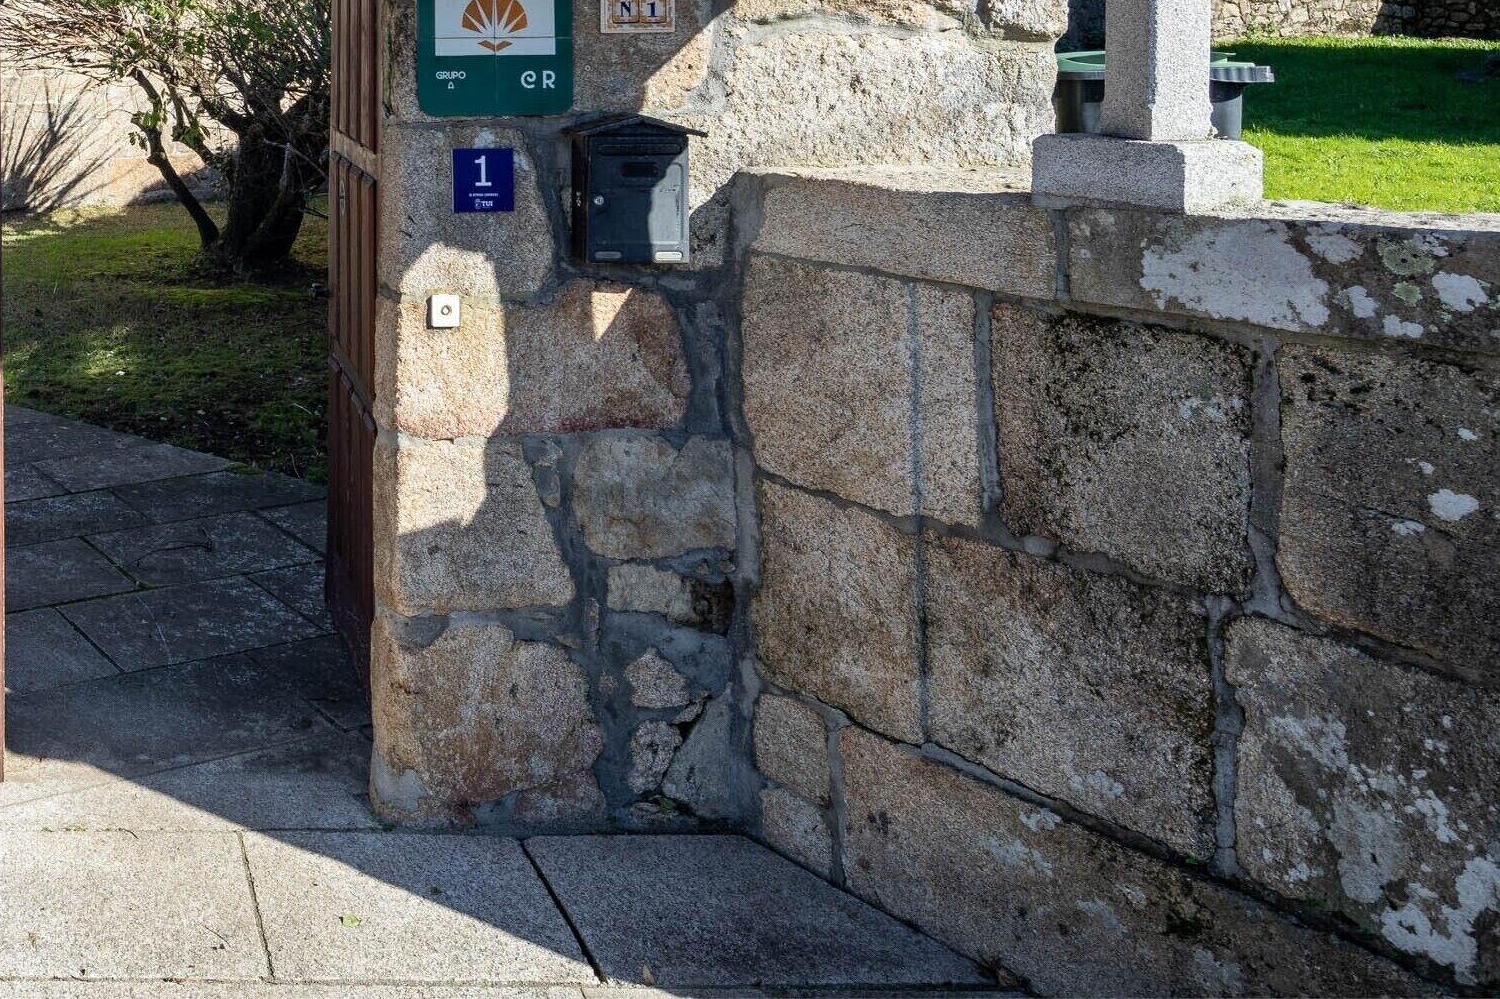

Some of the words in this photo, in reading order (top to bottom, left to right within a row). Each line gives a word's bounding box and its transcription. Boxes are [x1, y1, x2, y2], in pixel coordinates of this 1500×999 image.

[620, 1, 632, 18] N
[646, 1, 659, 18] 1
[435, 71, 467, 80] GRUPO
[474, 155, 492, 187] 1
